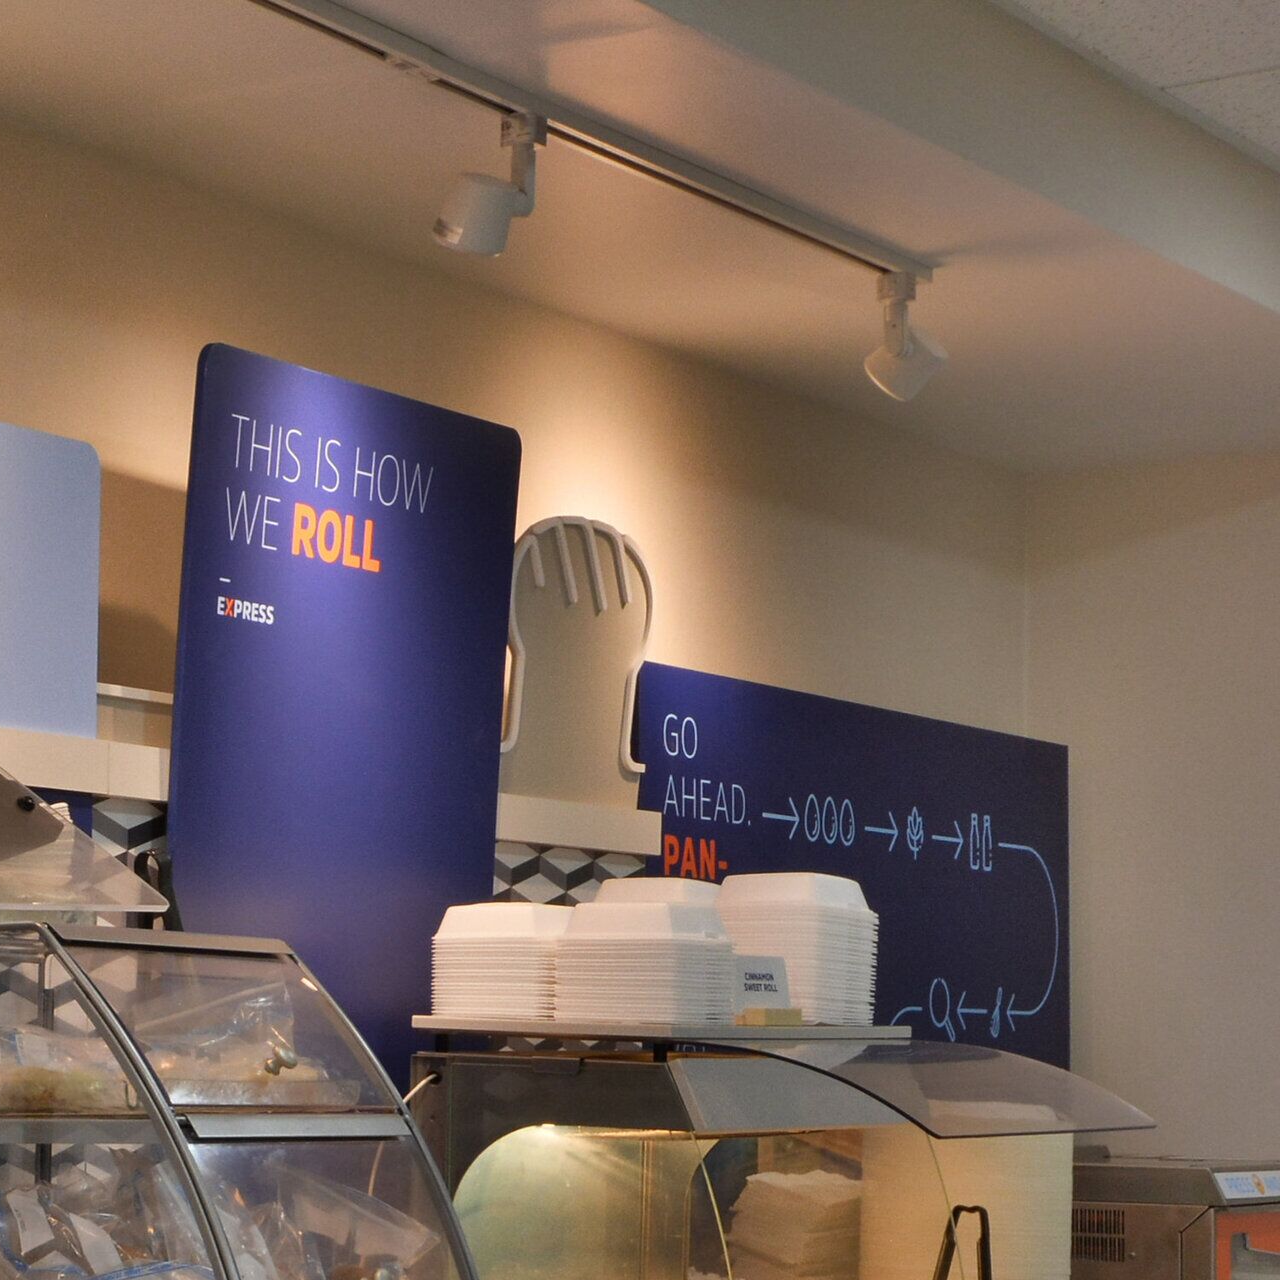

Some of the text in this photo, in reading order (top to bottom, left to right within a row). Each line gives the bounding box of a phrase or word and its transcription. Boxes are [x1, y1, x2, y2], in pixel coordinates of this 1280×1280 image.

[231, 413, 434, 514] THIS IS HOW
[226, 486, 382, 574] WE ROLL
[216, 595, 275, 626] EXPRESS
[662, 713, 698, 760] GO
[662, 774, 752, 827] AHEAD.
[663, 833, 728, 882] PAN-
